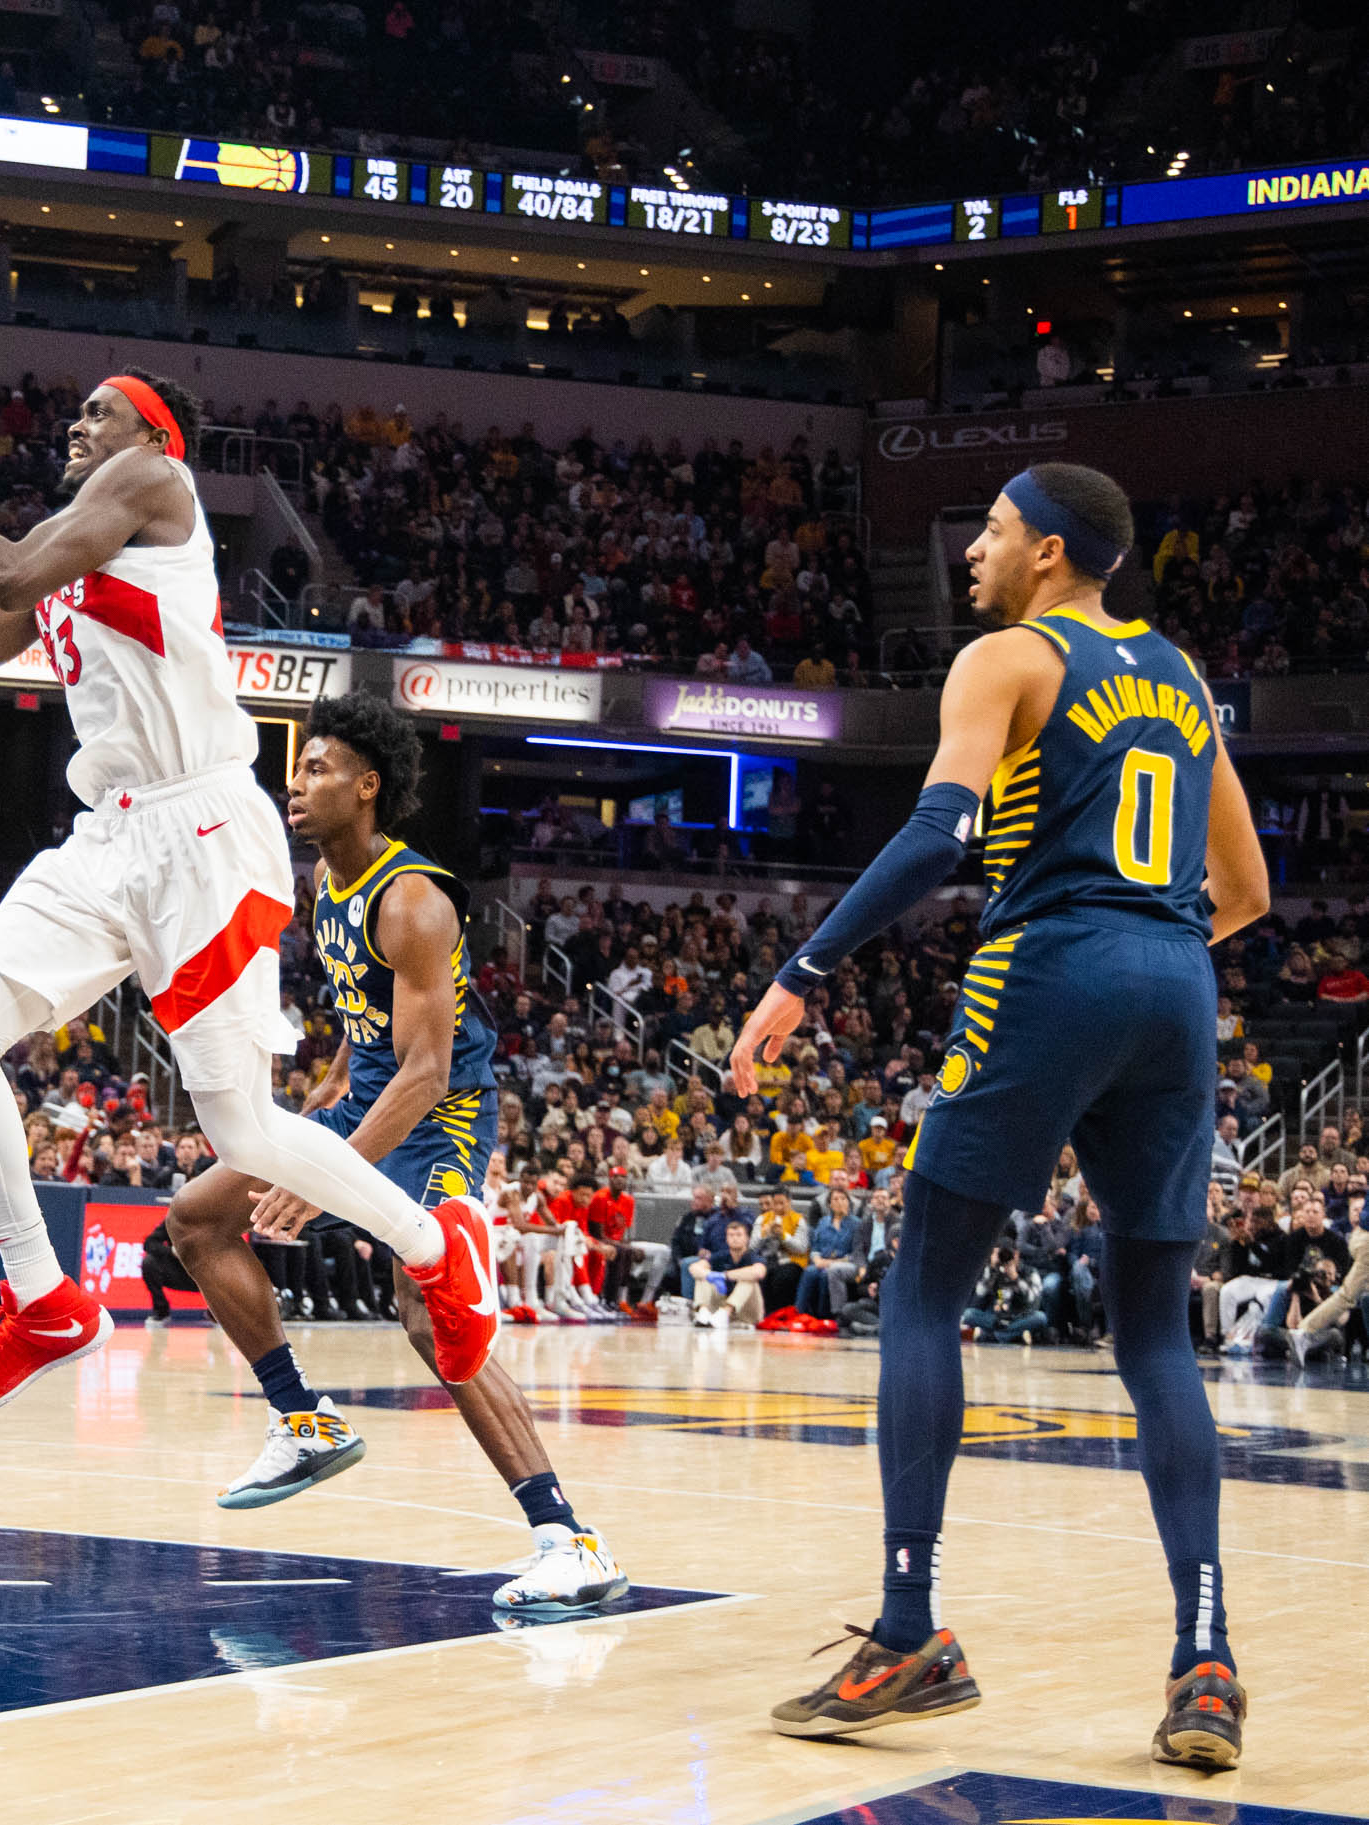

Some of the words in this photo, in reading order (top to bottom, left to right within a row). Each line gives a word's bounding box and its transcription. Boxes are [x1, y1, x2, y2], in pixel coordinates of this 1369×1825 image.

[367, 158, 397, 176] REB
[442, 167, 473, 184] AST
[364, 175, 399, 201] 45
[440, 183, 474, 209] 20
[512, 174, 554, 194] FIELD
[553, 180, 602, 198] GOALS
[1058, 189, 1088, 206] FLS
[1247, 167, 1369, 206] INDIANA
[517, 191, 594, 222] 40/84
[631, 187, 668, 206] FREE
[668, 190, 729, 212] THROWS
[761, 201, 819, 220] 3-POINT
[819, 207, 841, 223] FG
[963, 199, 992, 215] TOL
[644, 204, 713, 235] 18/21
[968, 216, 986, 240] 2
[1065, 206, 1078, 230] 1
[770, 217, 830, 246] 8/23
[931, 423, 1068, 448] LEXUS
[726, 697, 818, 722] DONUTS
[1066, 674, 1212, 757] HALIBURTON
[710, 719, 746, 731] SINCE
[752, 723, 780, 735] 1961
[1113, 747, 1176, 886] 0
[325, 953, 368, 1014] 23
